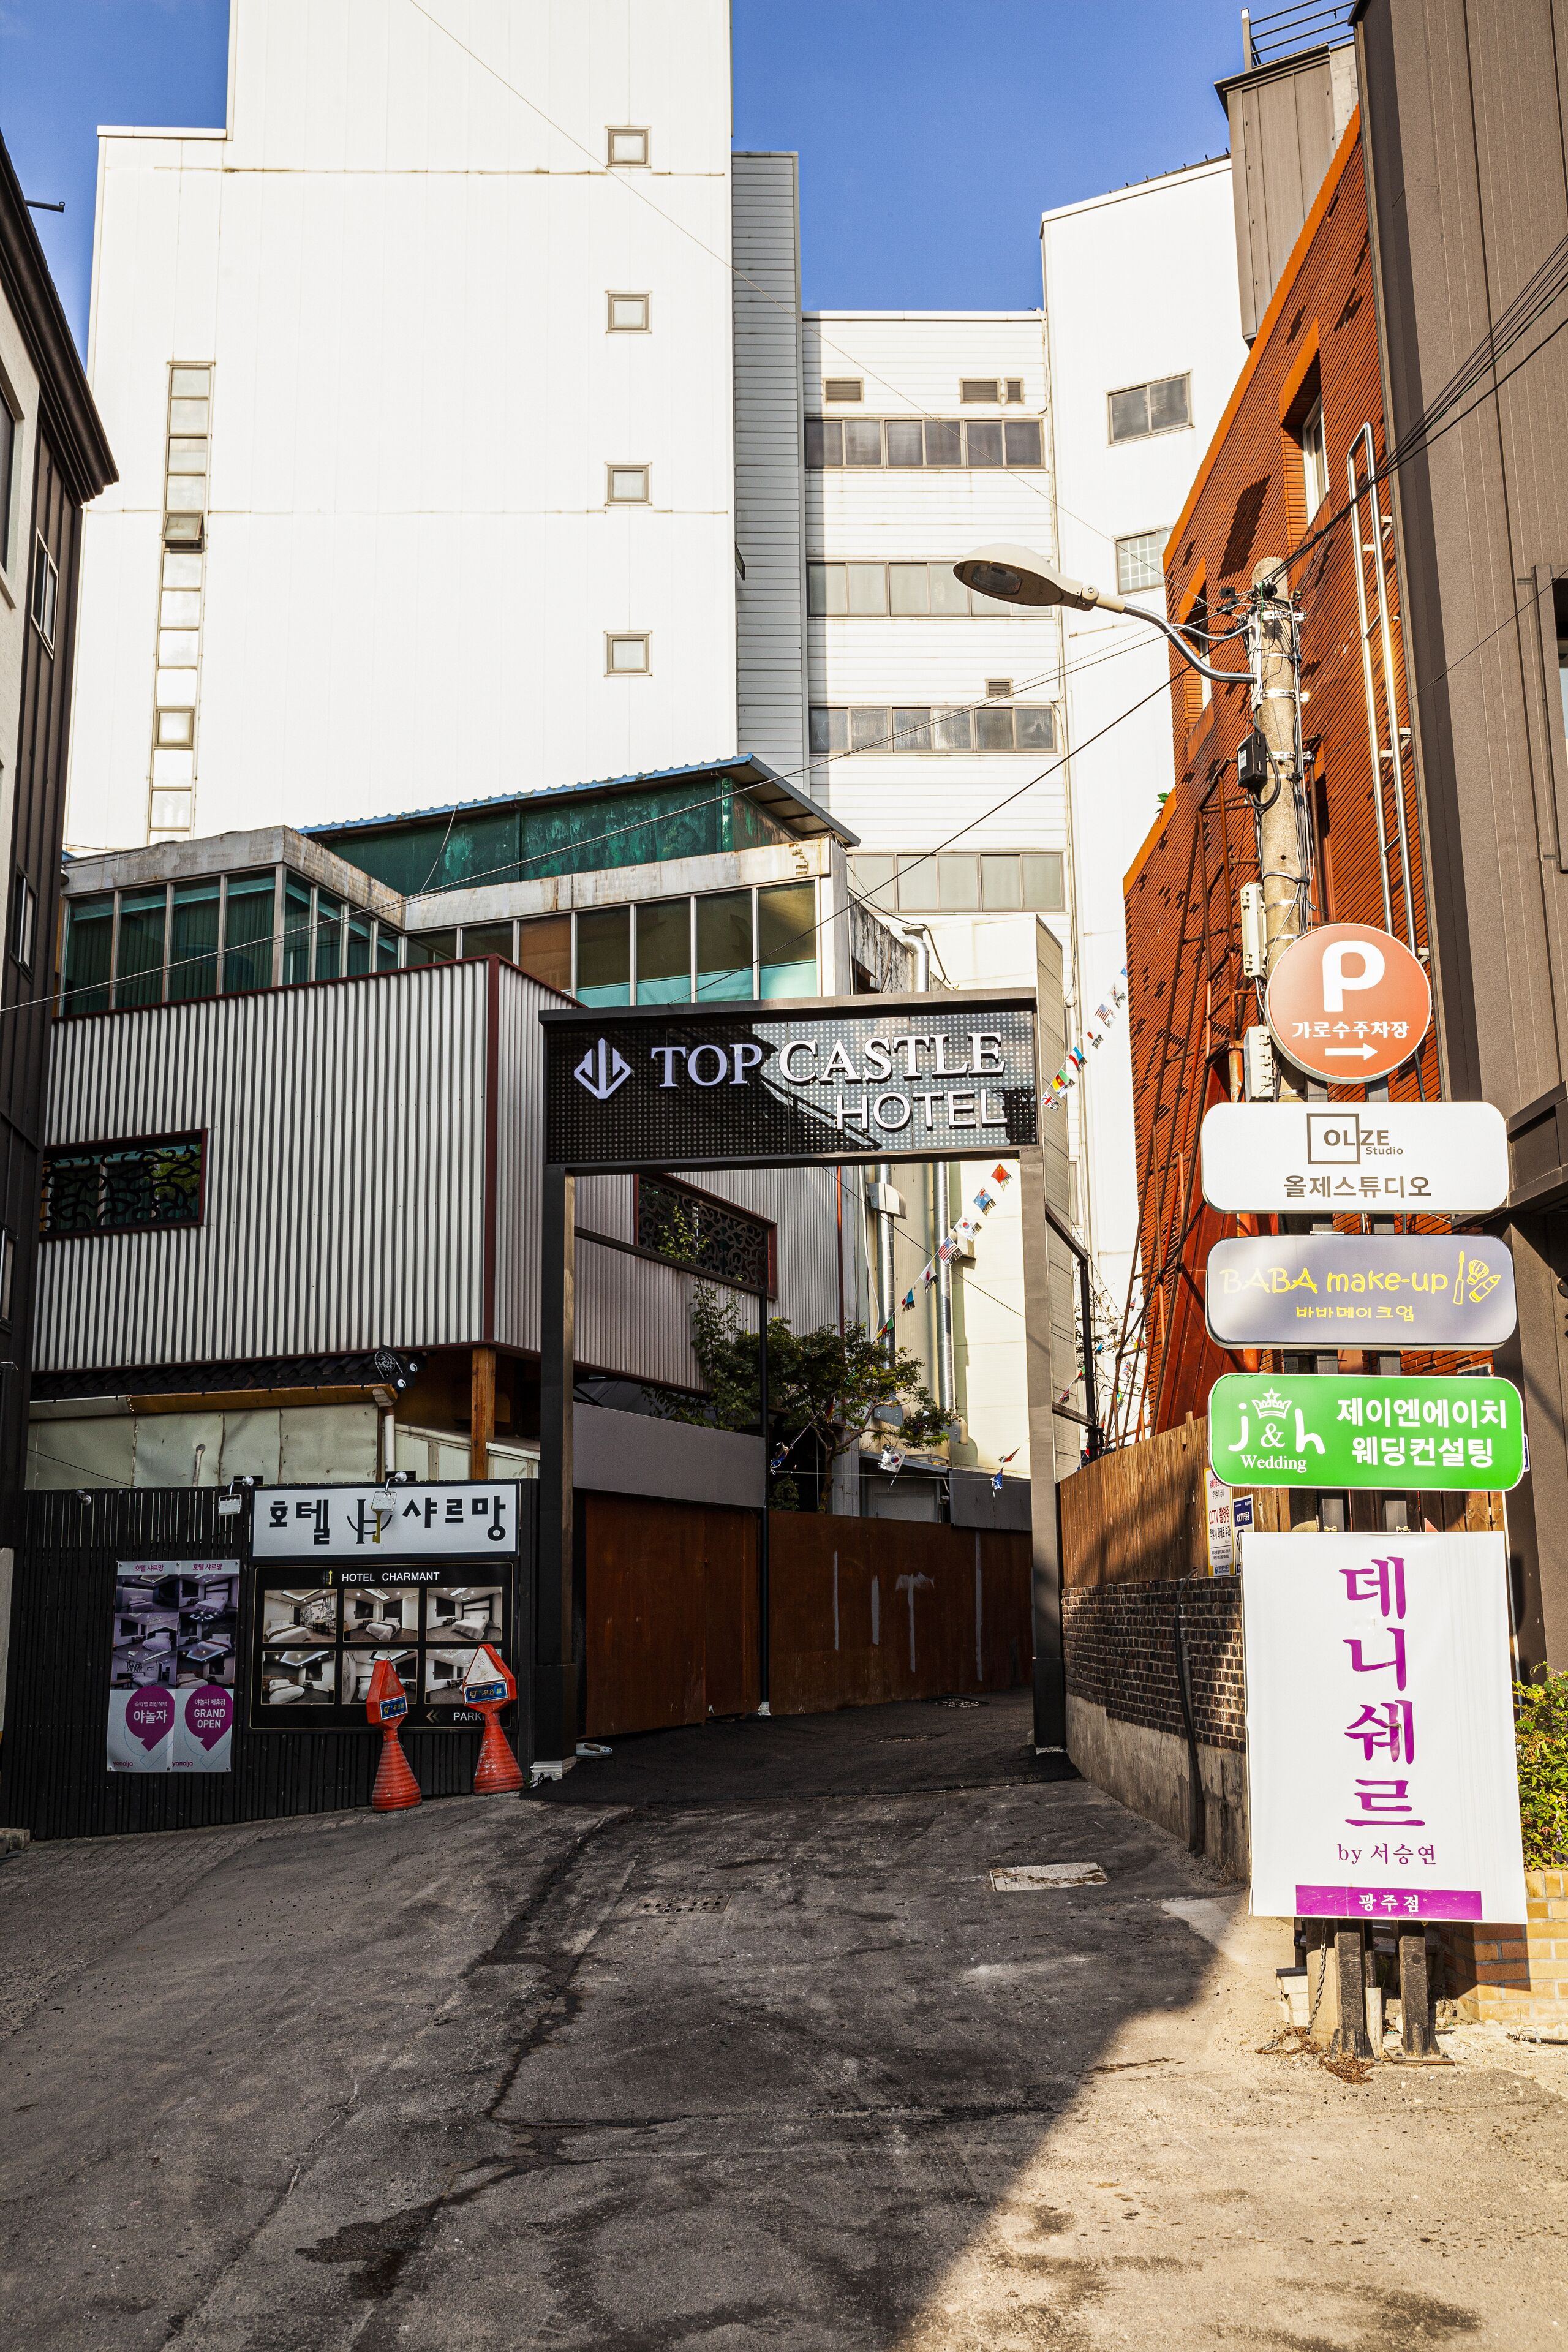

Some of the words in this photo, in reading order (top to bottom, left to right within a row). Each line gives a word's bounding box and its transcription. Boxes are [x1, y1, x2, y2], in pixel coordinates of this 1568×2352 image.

[1322, 940, 1385, 1012] P
[1291, 1021, 1410, 1039] 가로수주차장
[650, 1044, 763, 1088] TOP
[778, 1031, 1006, 1084] CASTLE
[836, 1088, 1008, 1131] HOTEL
[1324, 1129, 1389, 1146] OLZE
[1365, 1147, 1403, 1155] Studio
[1284, 1175, 1431, 1198] 올제스튜디오
[1219, 1267, 1318, 1294] BABA
[1327, 1269, 1448, 1294] make-up
[1296, 1305, 1414, 1322] 바바메이크업
[1336, 1397, 1507, 1429] 제이엔에이치
[1352, 1436, 1493, 1468] 웨딩컨설팅
[1240, 1455, 1308, 1473] Wedding
[269, 1499, 330, 1545] 호텔
[402, 1495, 507, 1542] 샤르망
[1209, 1509, 1219, 1524] CCTV
[1219, 1506, 1230, 1523] 촬영중
[342, 1574, 375, 1582] HOTEL
[382, 1572, 440, 1581] CHARMANT
[1338, 1556, 1426, 1828] 데니쉐르
[134, 1709, 168, 1724] 야놀자
[194, 1709, 225, 1717] GRAND
[453, 1712, 484, 1721] PARKI
[197, 1719, 221, 1728] OPEN
[1337, 1843, 1362, 1864] by
[1371, 1843, 1437, 1866] 서승연
[1357, 1893, 1419, 1913] 광주점
